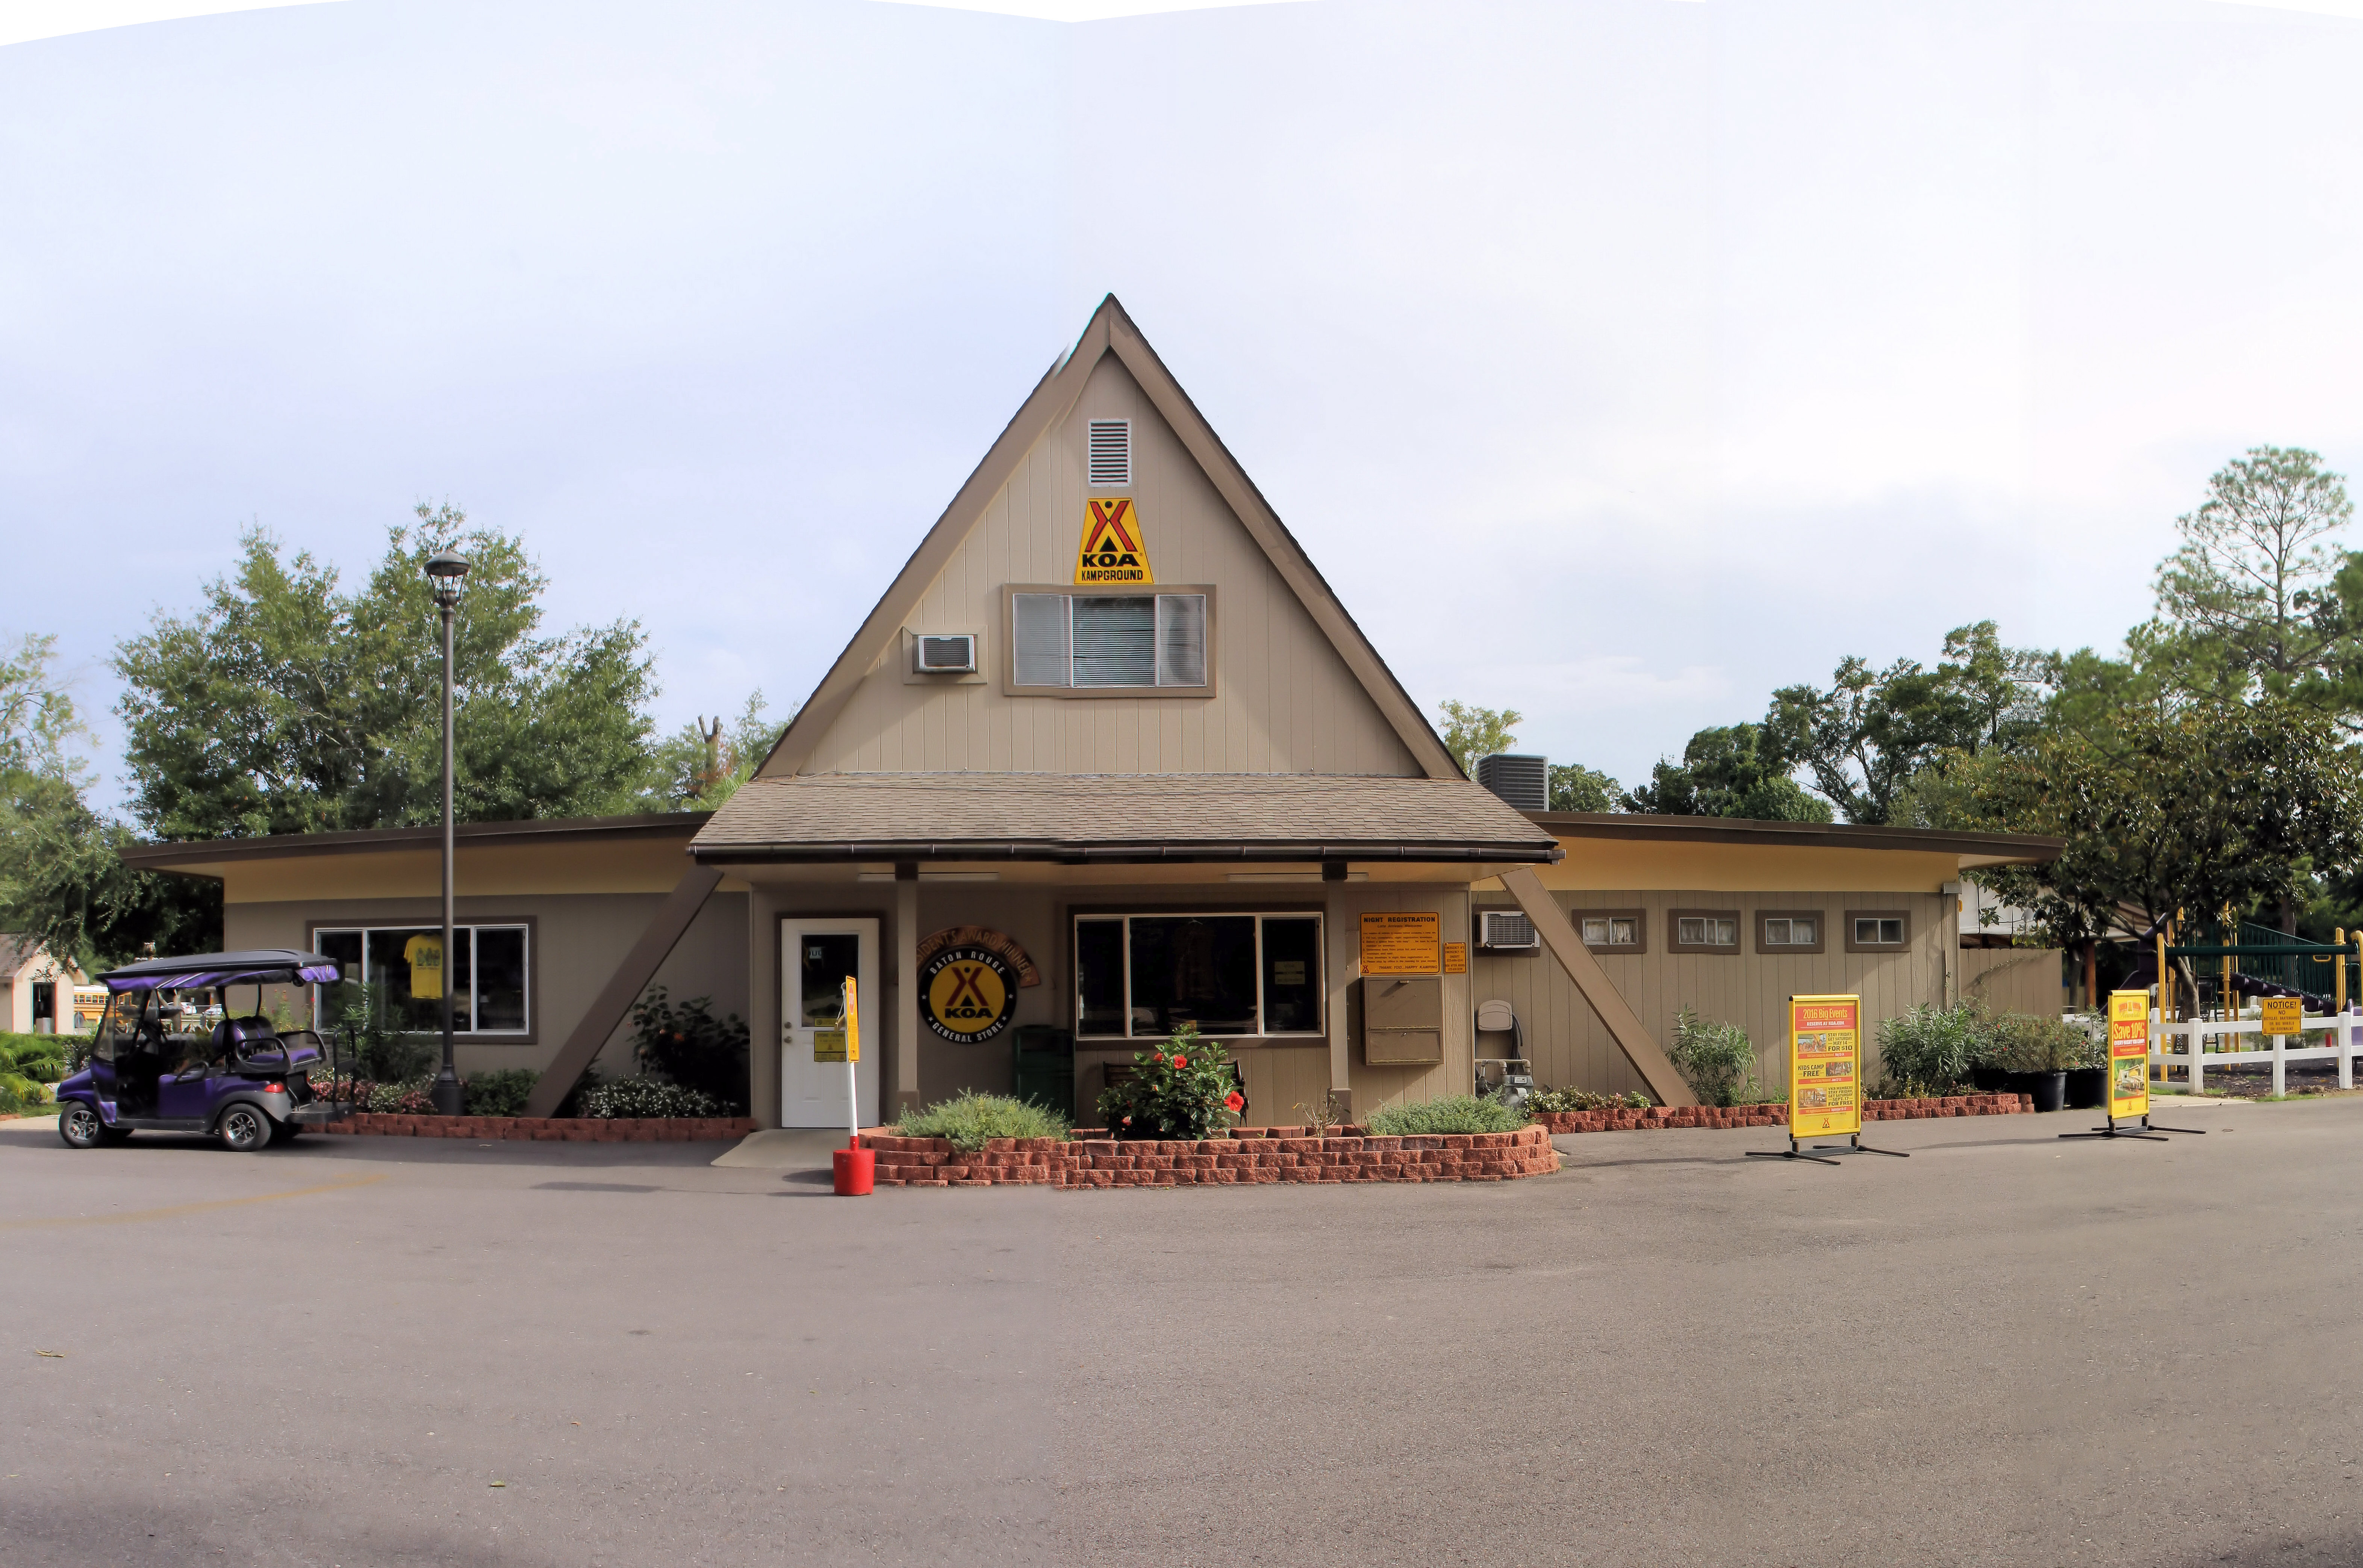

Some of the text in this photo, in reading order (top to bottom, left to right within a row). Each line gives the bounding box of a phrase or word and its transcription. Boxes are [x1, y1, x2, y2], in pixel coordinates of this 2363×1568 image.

[1082, 553, 1140, 567] KOA
[1082, 570, 1143, 581] KAMPGROUND
[959, 929, 998, 945] AWARD
[999, 939, 1032, 976] WINNER
[929, 951, 1005, 974] BATON ROUGE
[945, 1008, 993, 1018] KOA
[1803, 1008, 1848, 1020] 2016 Big Events
[932, 1021, 1003, 1042] GENERAL STORE
[2114, 1023, 2130, 1040] Save
